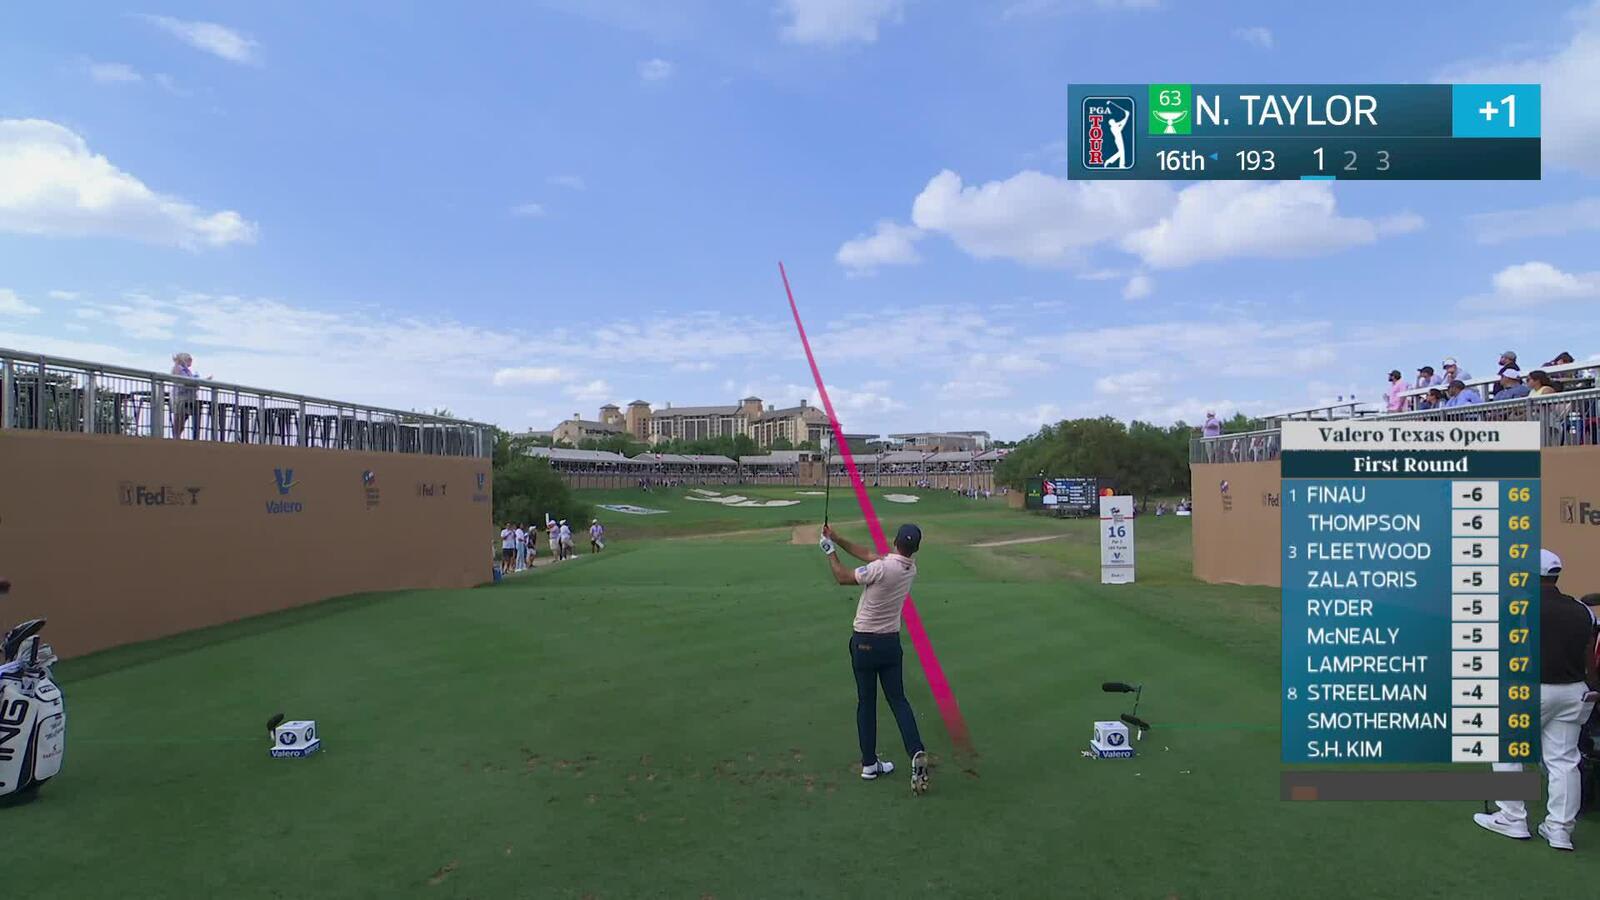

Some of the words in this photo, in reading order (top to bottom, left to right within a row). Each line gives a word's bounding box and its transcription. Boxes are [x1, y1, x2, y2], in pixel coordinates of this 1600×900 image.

[265, 500, 303, 514] Valero
[1108, 526, 1127, 538] 16
[1102, 750, 1131, 758] Valero
